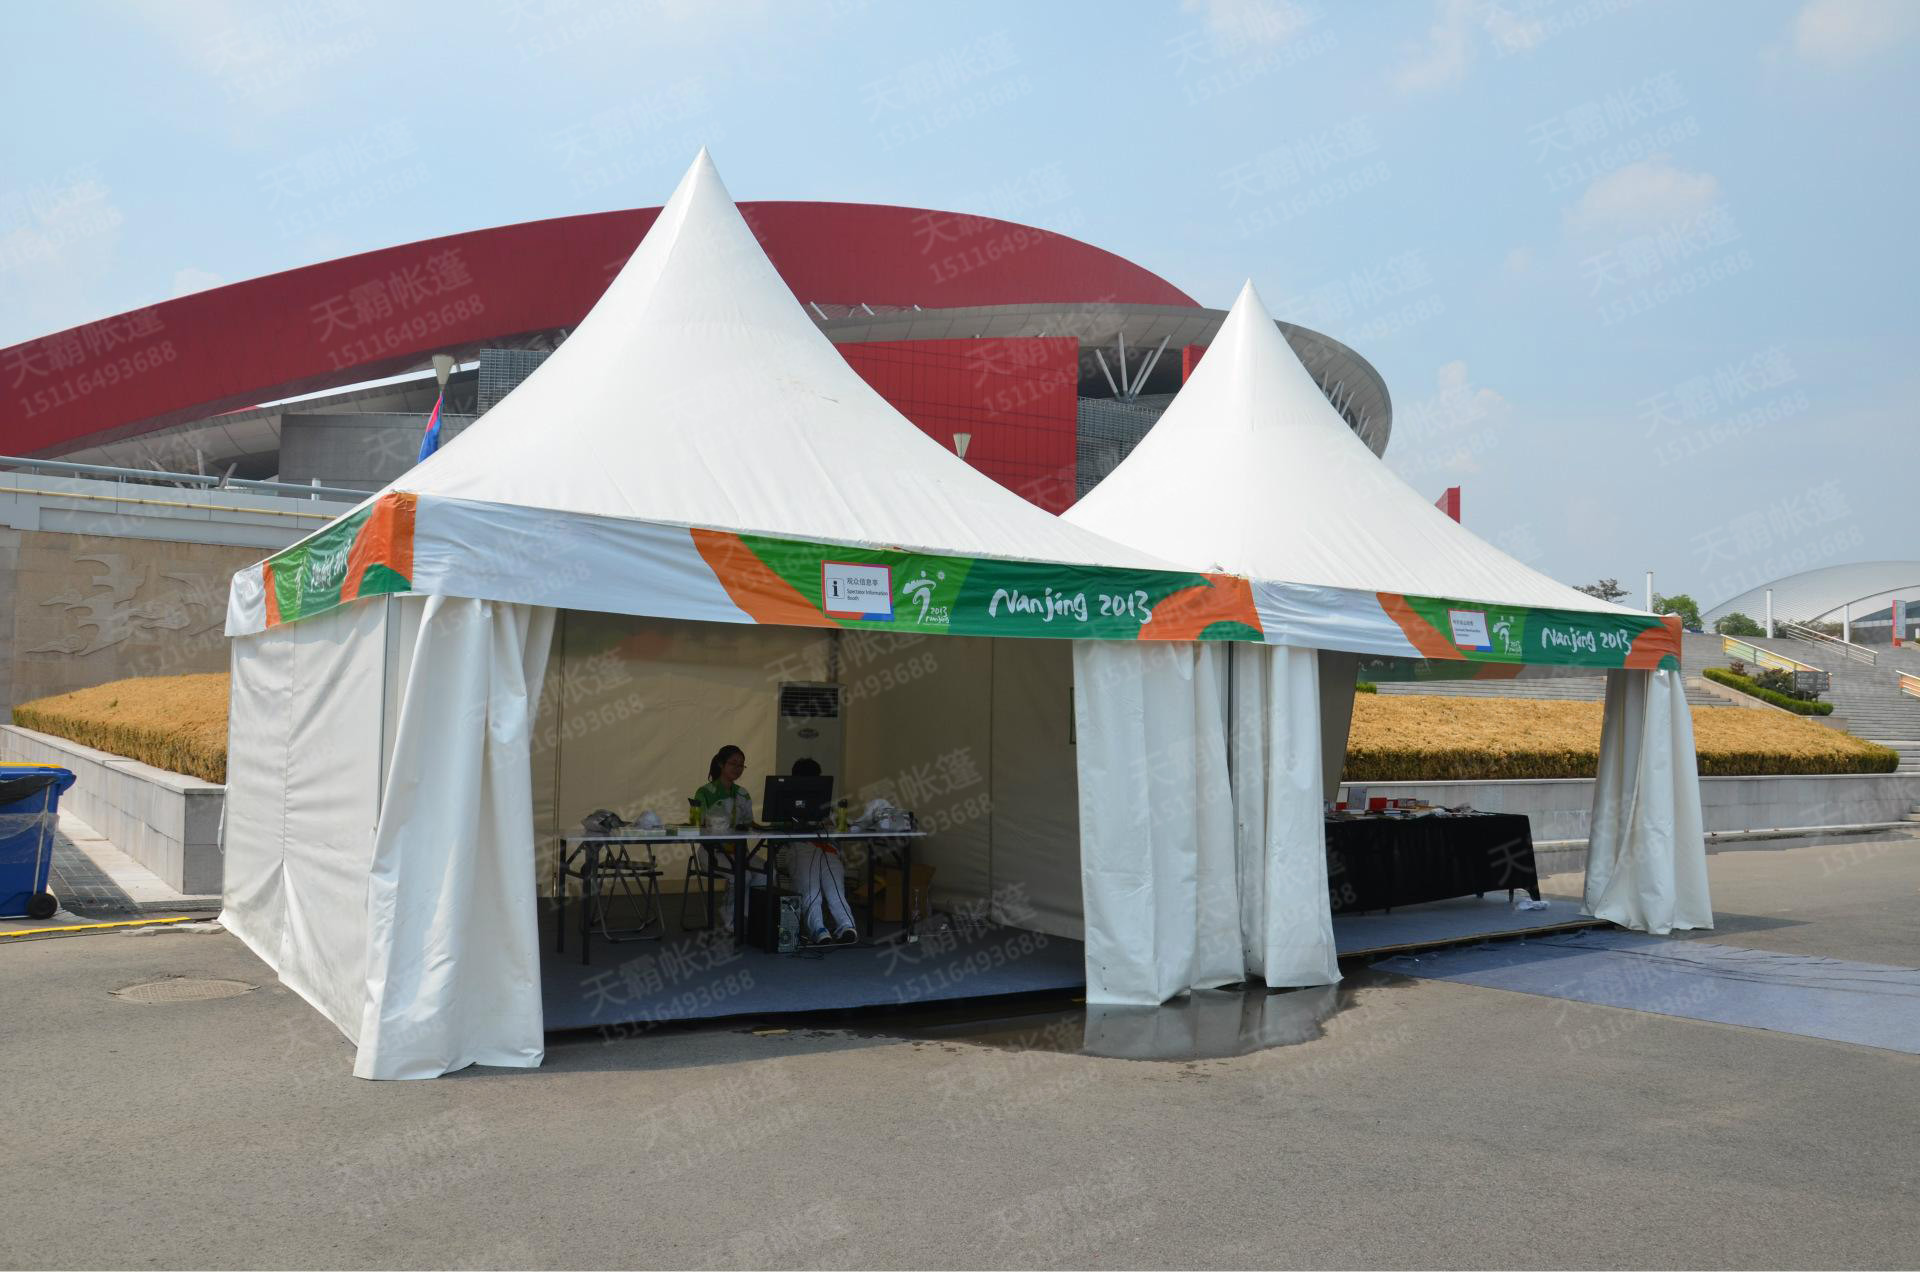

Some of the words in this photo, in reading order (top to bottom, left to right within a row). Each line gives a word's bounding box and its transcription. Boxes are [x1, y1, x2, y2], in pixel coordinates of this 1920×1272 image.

[930, 606, 948, 617] 2013
[988, 587, 1088, 622] Nanjing
[1099, 590, 1153, 625] 2013
[1541, 627, 1597, 653] Nanjing
[1600, 628, 1632, 656] 2013
